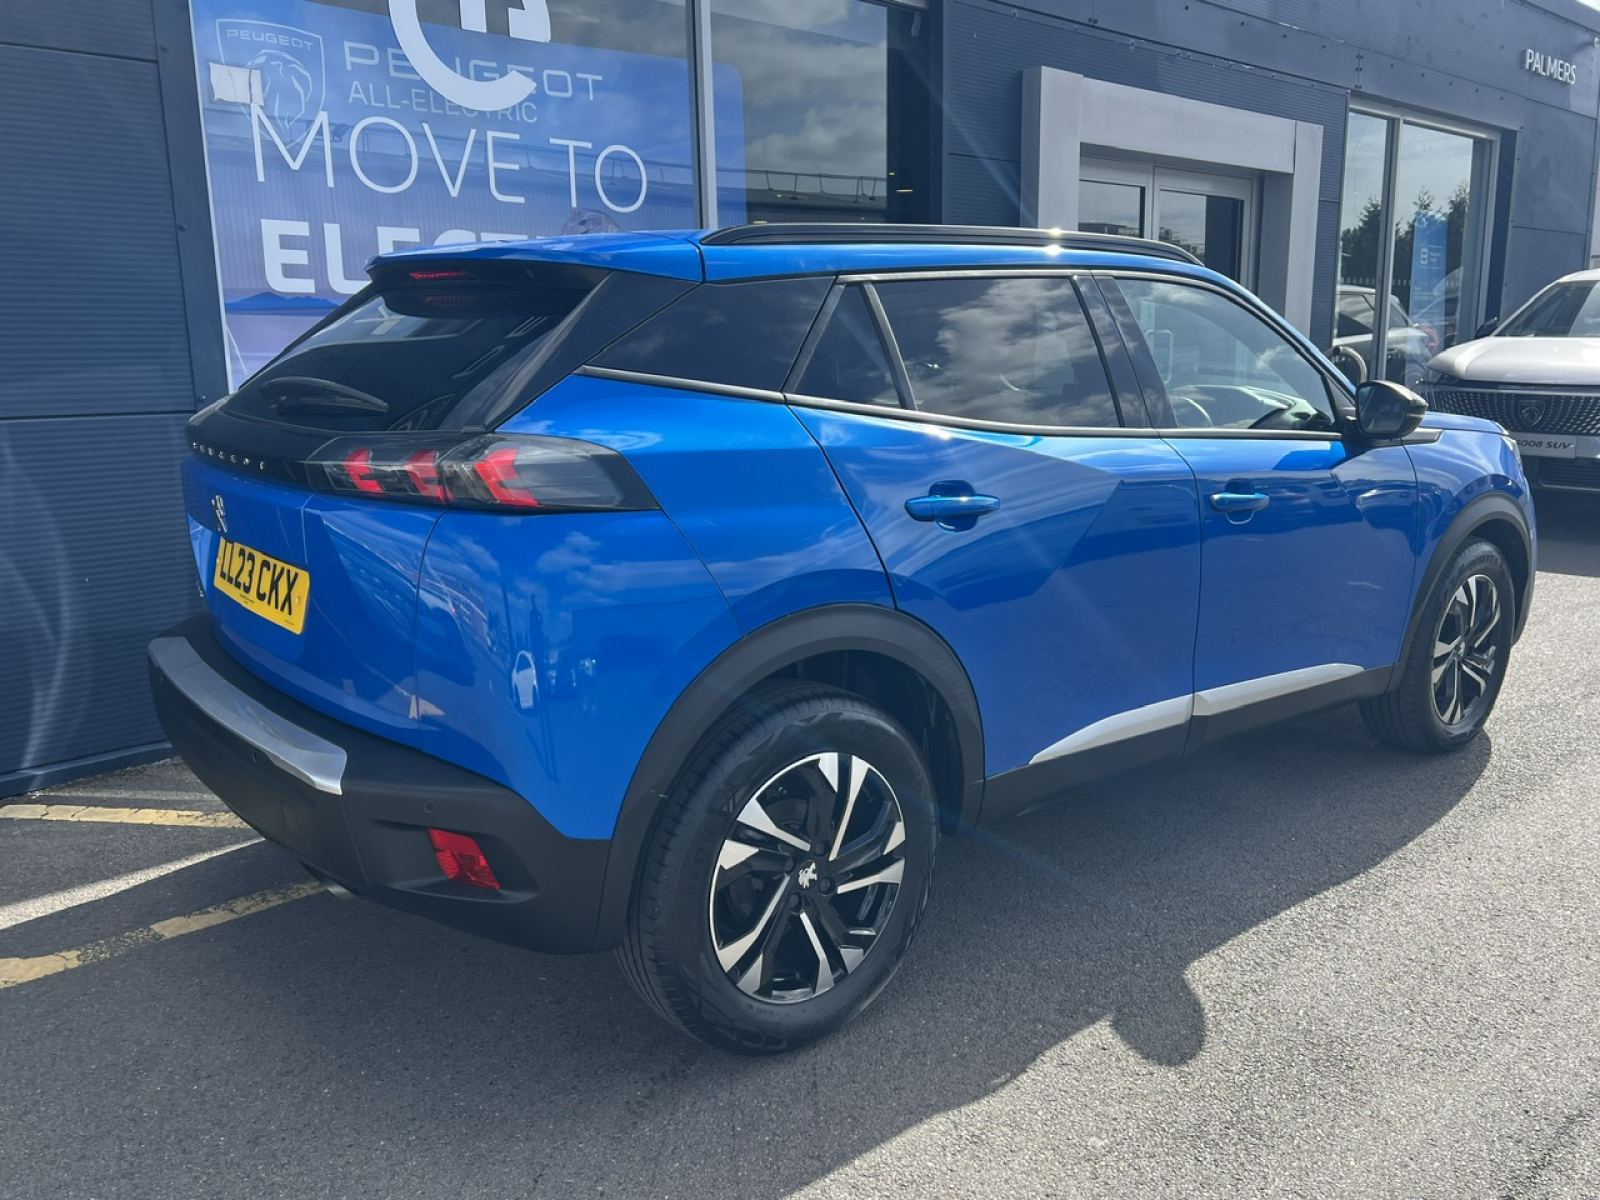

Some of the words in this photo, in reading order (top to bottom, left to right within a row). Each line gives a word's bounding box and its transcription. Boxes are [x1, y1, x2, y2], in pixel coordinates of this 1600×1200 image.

[226, 29, 315, 51] PEUGEOT
[343, 40, 604, 101] PEGOT
[1524, 48, 1577, 85] PALMERS
[348, 80, 538, 123] ALL-ELERIC
[250, 103, 526, 204] MOVE
[549, 137, 648, 213] TO
[1545, 440, 1571, 450] SUV
[219, 540, 256, 595] LL23
[256, 559, 300, 616] CKX
